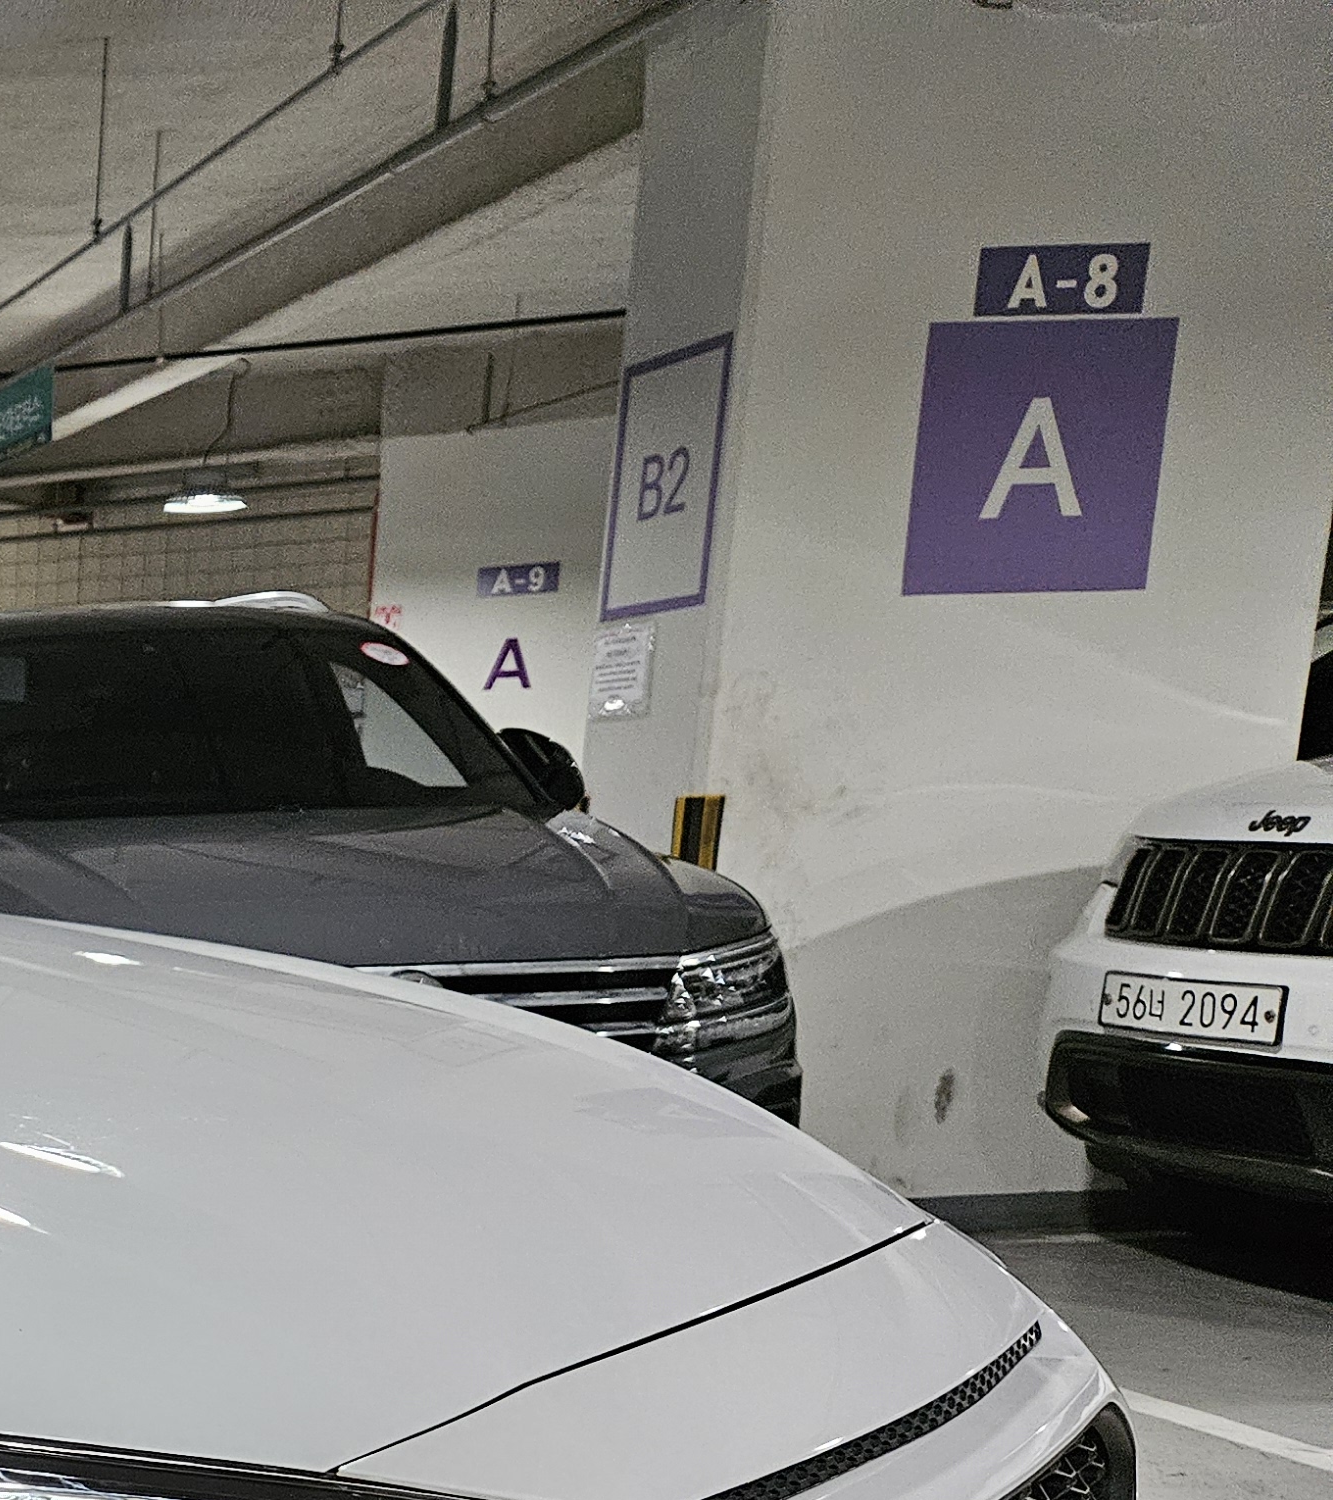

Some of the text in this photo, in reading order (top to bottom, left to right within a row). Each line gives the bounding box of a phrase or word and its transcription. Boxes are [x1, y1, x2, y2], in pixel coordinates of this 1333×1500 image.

[1007, 253, 1119, 309] A-8
[637, 446, 690, 521] B2
[979, 397, 1083, 519] A
[490, 565, 546, 594] A-9
[483, 637, 532, 691] A
[1248, 810, 1312, 837] Jeep
[1179, 989, 1260, 1033] 2094
